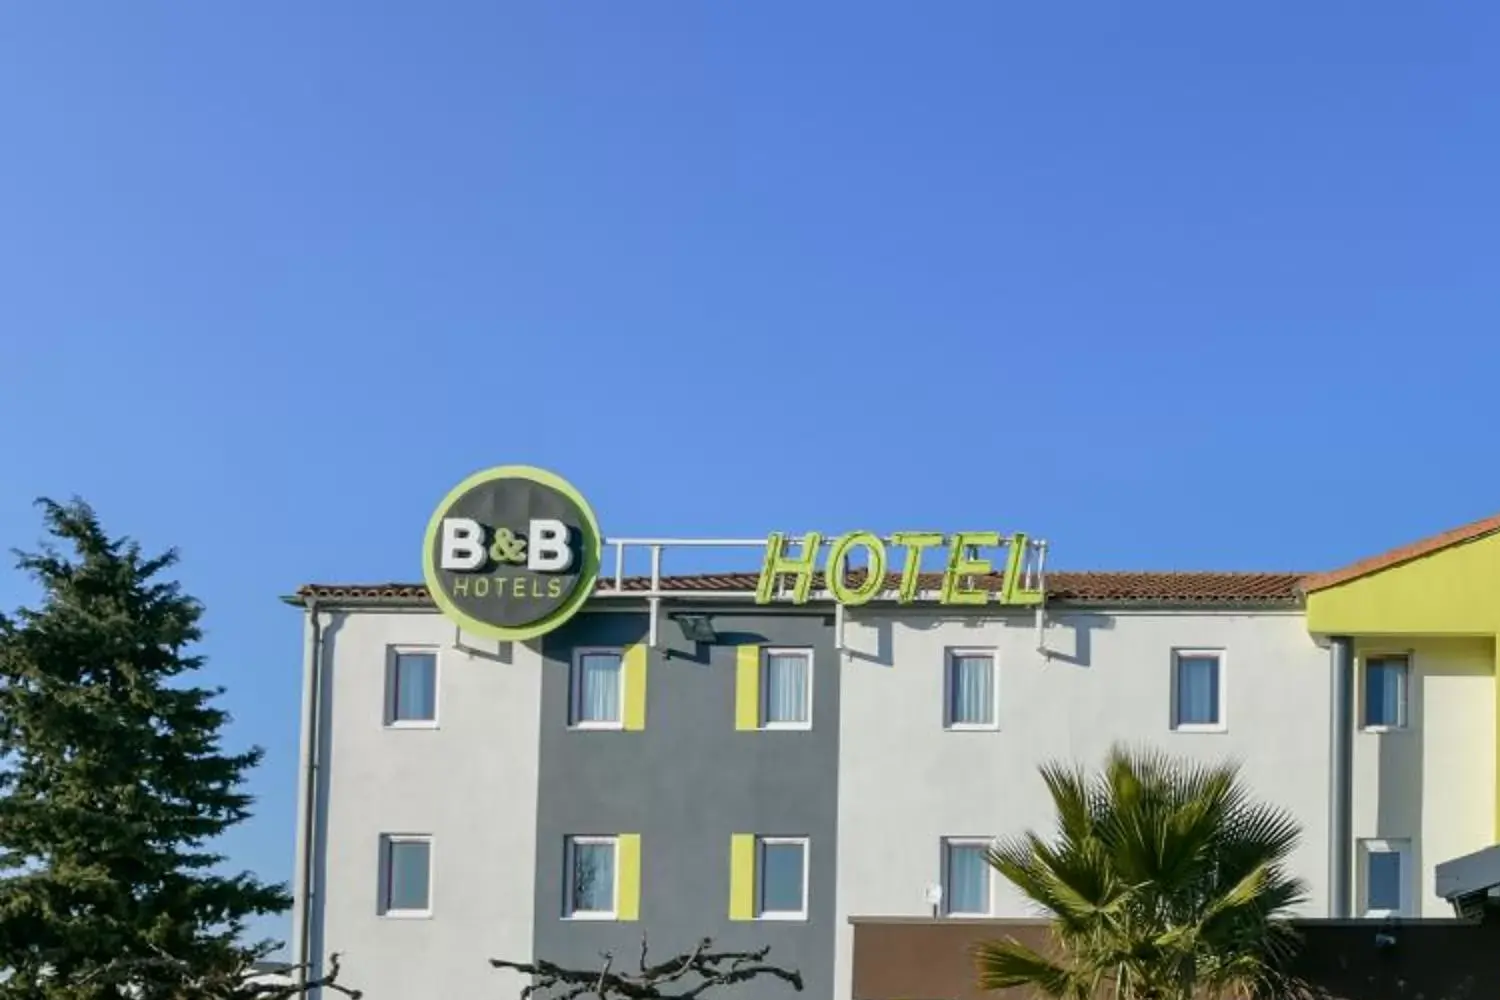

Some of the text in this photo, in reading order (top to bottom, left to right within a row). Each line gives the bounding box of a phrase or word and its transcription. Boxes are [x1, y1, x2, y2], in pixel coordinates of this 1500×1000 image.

[441, 518, 573, 571] B&B
[755, 531, 1045, 606] HOTEL
[453, 577, 562, 598] HOTELS
